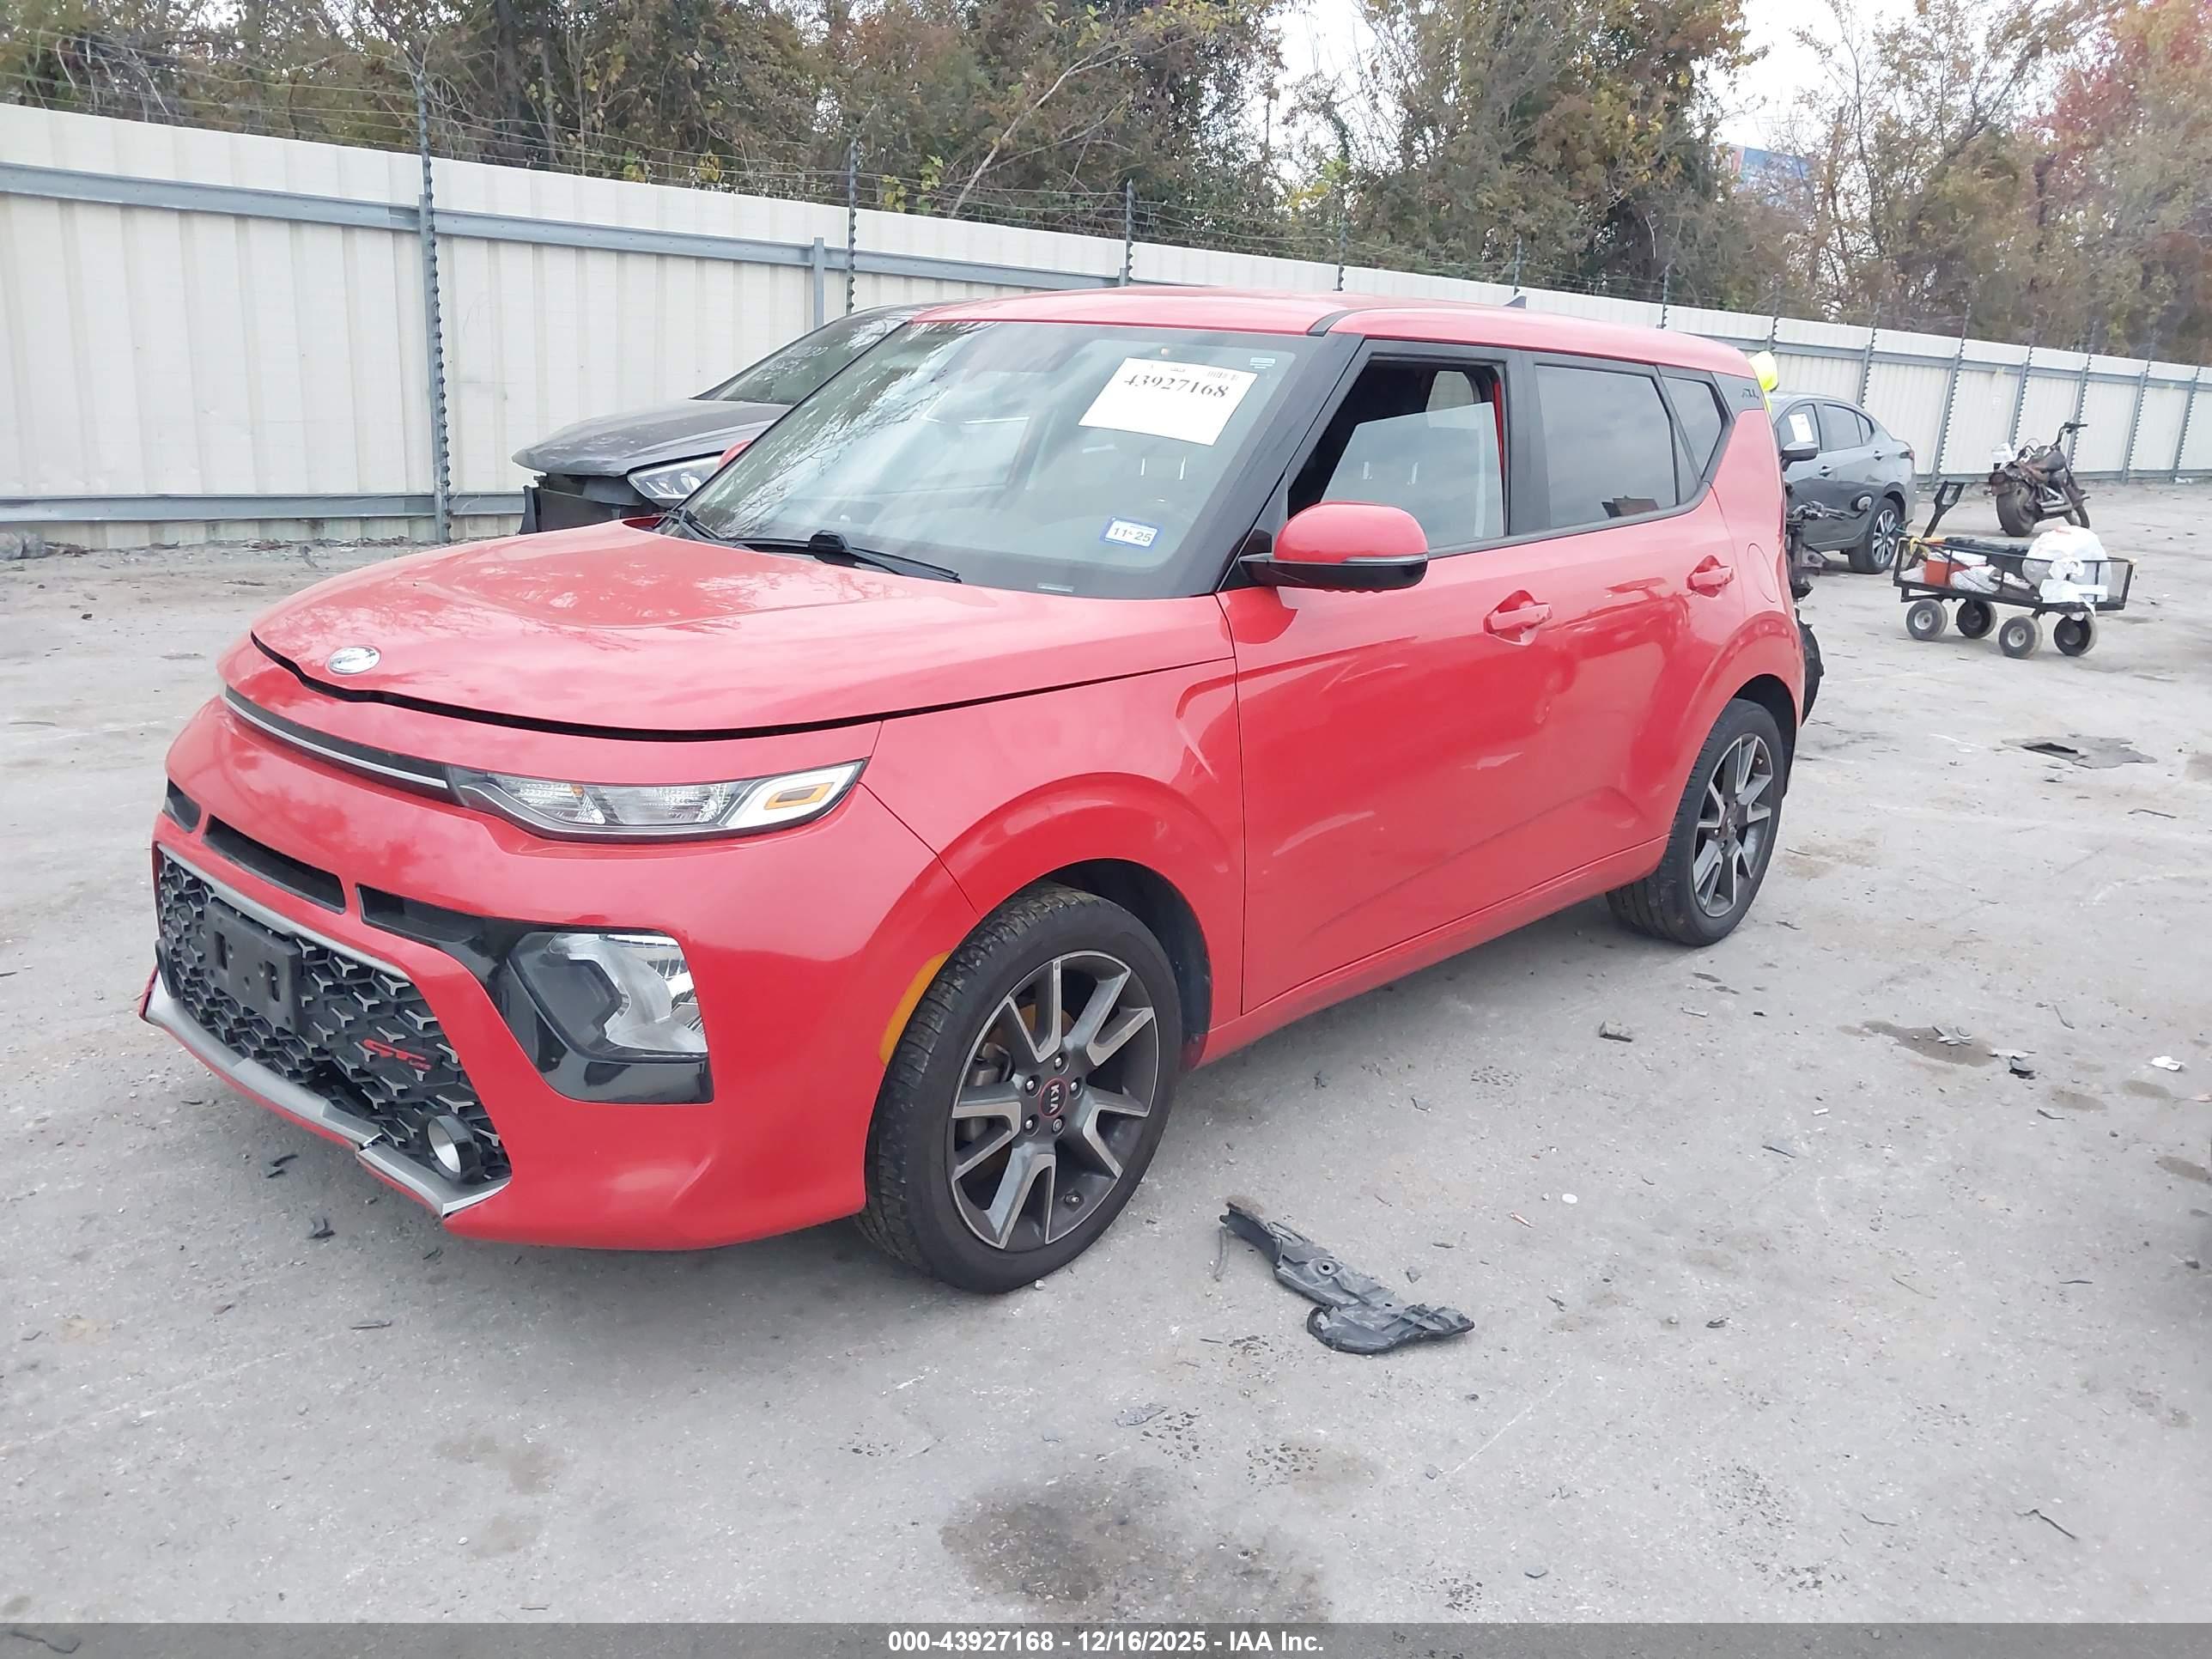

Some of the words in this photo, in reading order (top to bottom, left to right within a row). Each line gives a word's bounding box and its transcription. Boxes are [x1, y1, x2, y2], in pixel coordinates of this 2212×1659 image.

[1124, 374, 1229, 398] 43927168
[1114, 527, 1127, 538] 11
[1133, 531, 1152, 543] 25
[1049, 1084, 1060, 1114] KIA
